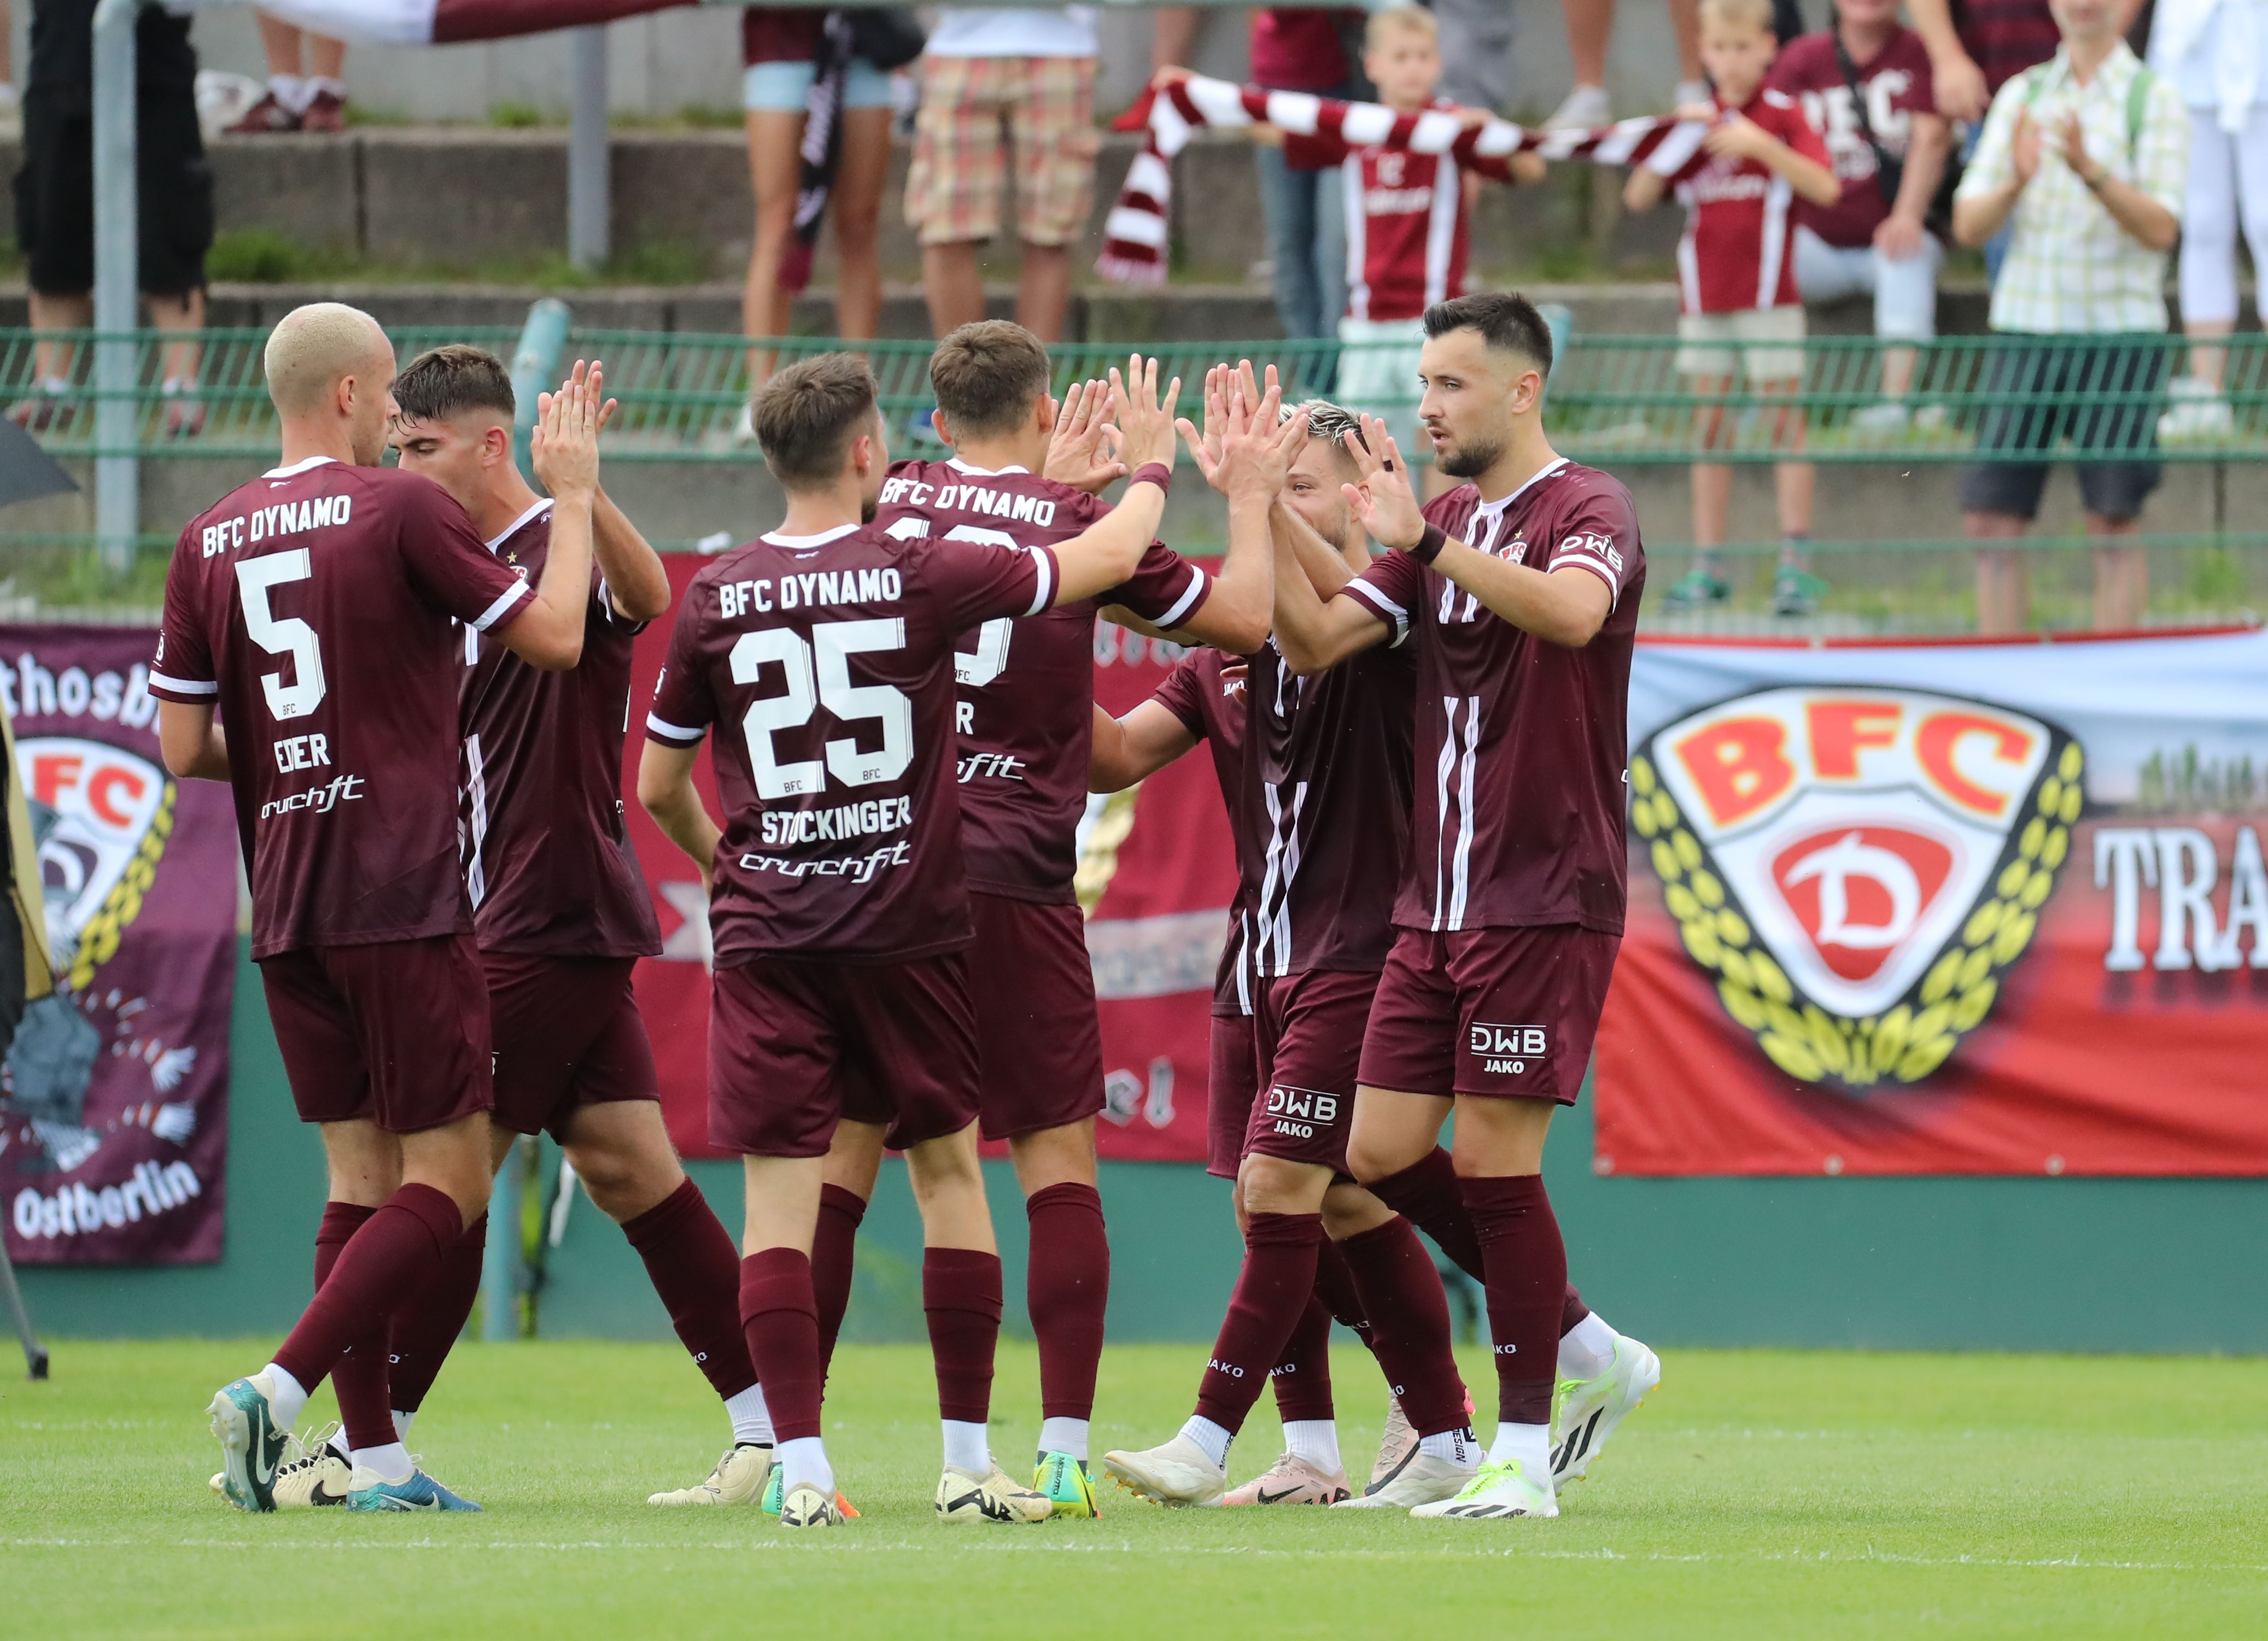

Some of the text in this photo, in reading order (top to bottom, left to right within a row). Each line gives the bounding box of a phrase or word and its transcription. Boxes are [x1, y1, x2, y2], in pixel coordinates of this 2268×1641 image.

[878, 477, 1056, 527] BFC DYNAMO
[202, 495, 352, 559] BFC DYNAMO
[719, 568, 902, 619] BFC DYNAMO
[235, 547, 326, 722] 5
[282, 703, 296, 716] BFC
[729, 617, 914, 800] 25
[273, 733, 331, 773] EDER
[863, 768, 881, 781] BFC
[1672, 699, 2036, 829] BFC
[784, 780, 803, 793] BFC
[761, 795, 912, 844] STOCKINGER
[739, 840, 911, 883] crunchfit
[1484, 1059, 1524, 1074] JAKO
[1273, 1120, 1313, 1139] JAKO
[13, 1159, 202, 1240] Ostberlin
